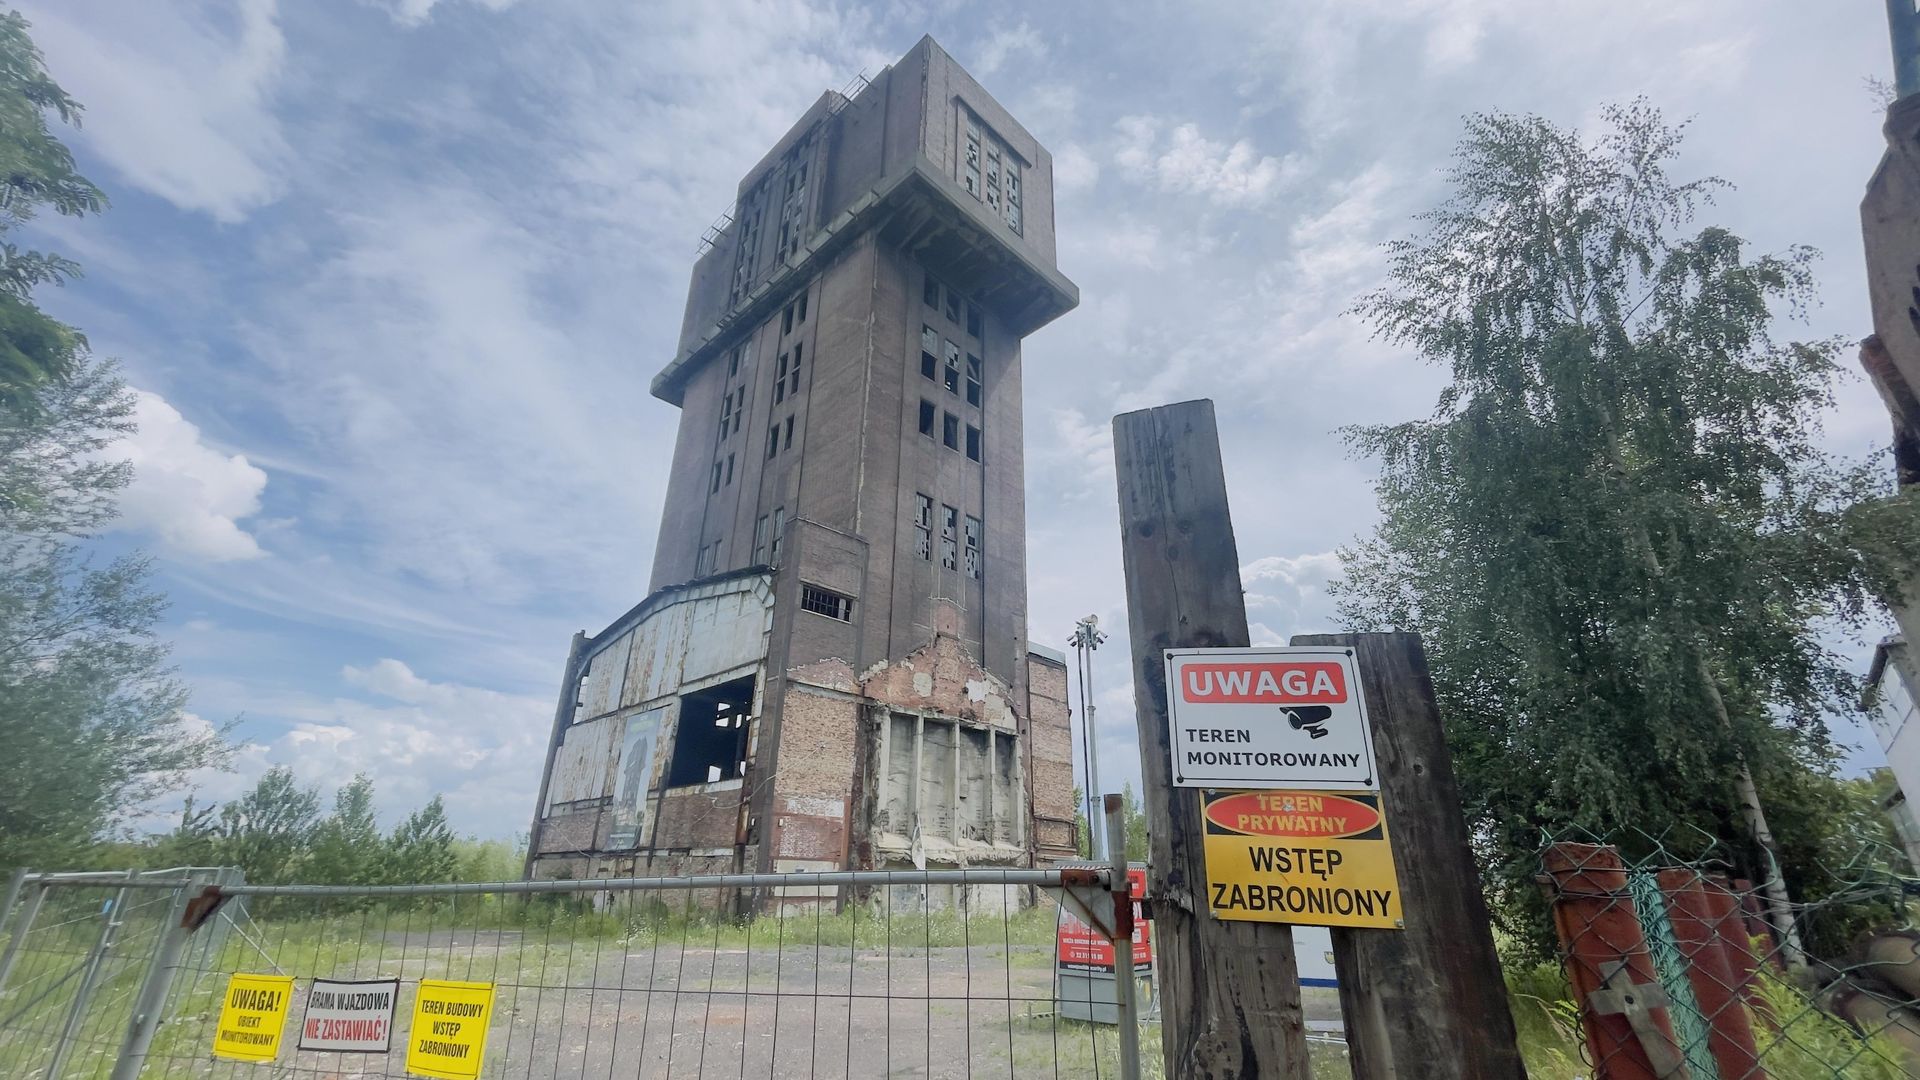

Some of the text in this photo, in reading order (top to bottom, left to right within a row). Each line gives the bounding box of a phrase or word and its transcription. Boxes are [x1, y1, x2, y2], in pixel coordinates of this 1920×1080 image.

[1188, 670, 1338, 696] UWAGA
[1185, 729, 1251, 743] TEREN
[1187, 751, 1360, 768] MONITOROWANY
[1259, 794, 1323, 812] TEREN
[1237, 814, 1347, 833] PRYWATNY
[1249, 846, 1343, 881] WSTĘP
[1212, 883, 1392, 917] ZABRONIONY
[231, 988, 282, 1012] UWAGA!
[310, 991, 390, 1011] BRAMA WJAZDOWA
[421, 999, 484, 1018] TEREN BUDOWY
[237, 1015, 262, 1028] OBIEKT
[304, 1017, 321, 1040] NIE
[432, 1020, 461, 1040] WSTĘP
[221, 1029, 275, 1046] MONITOROWANY
[418, 1039, 470, 1059] ZABRONIONY
